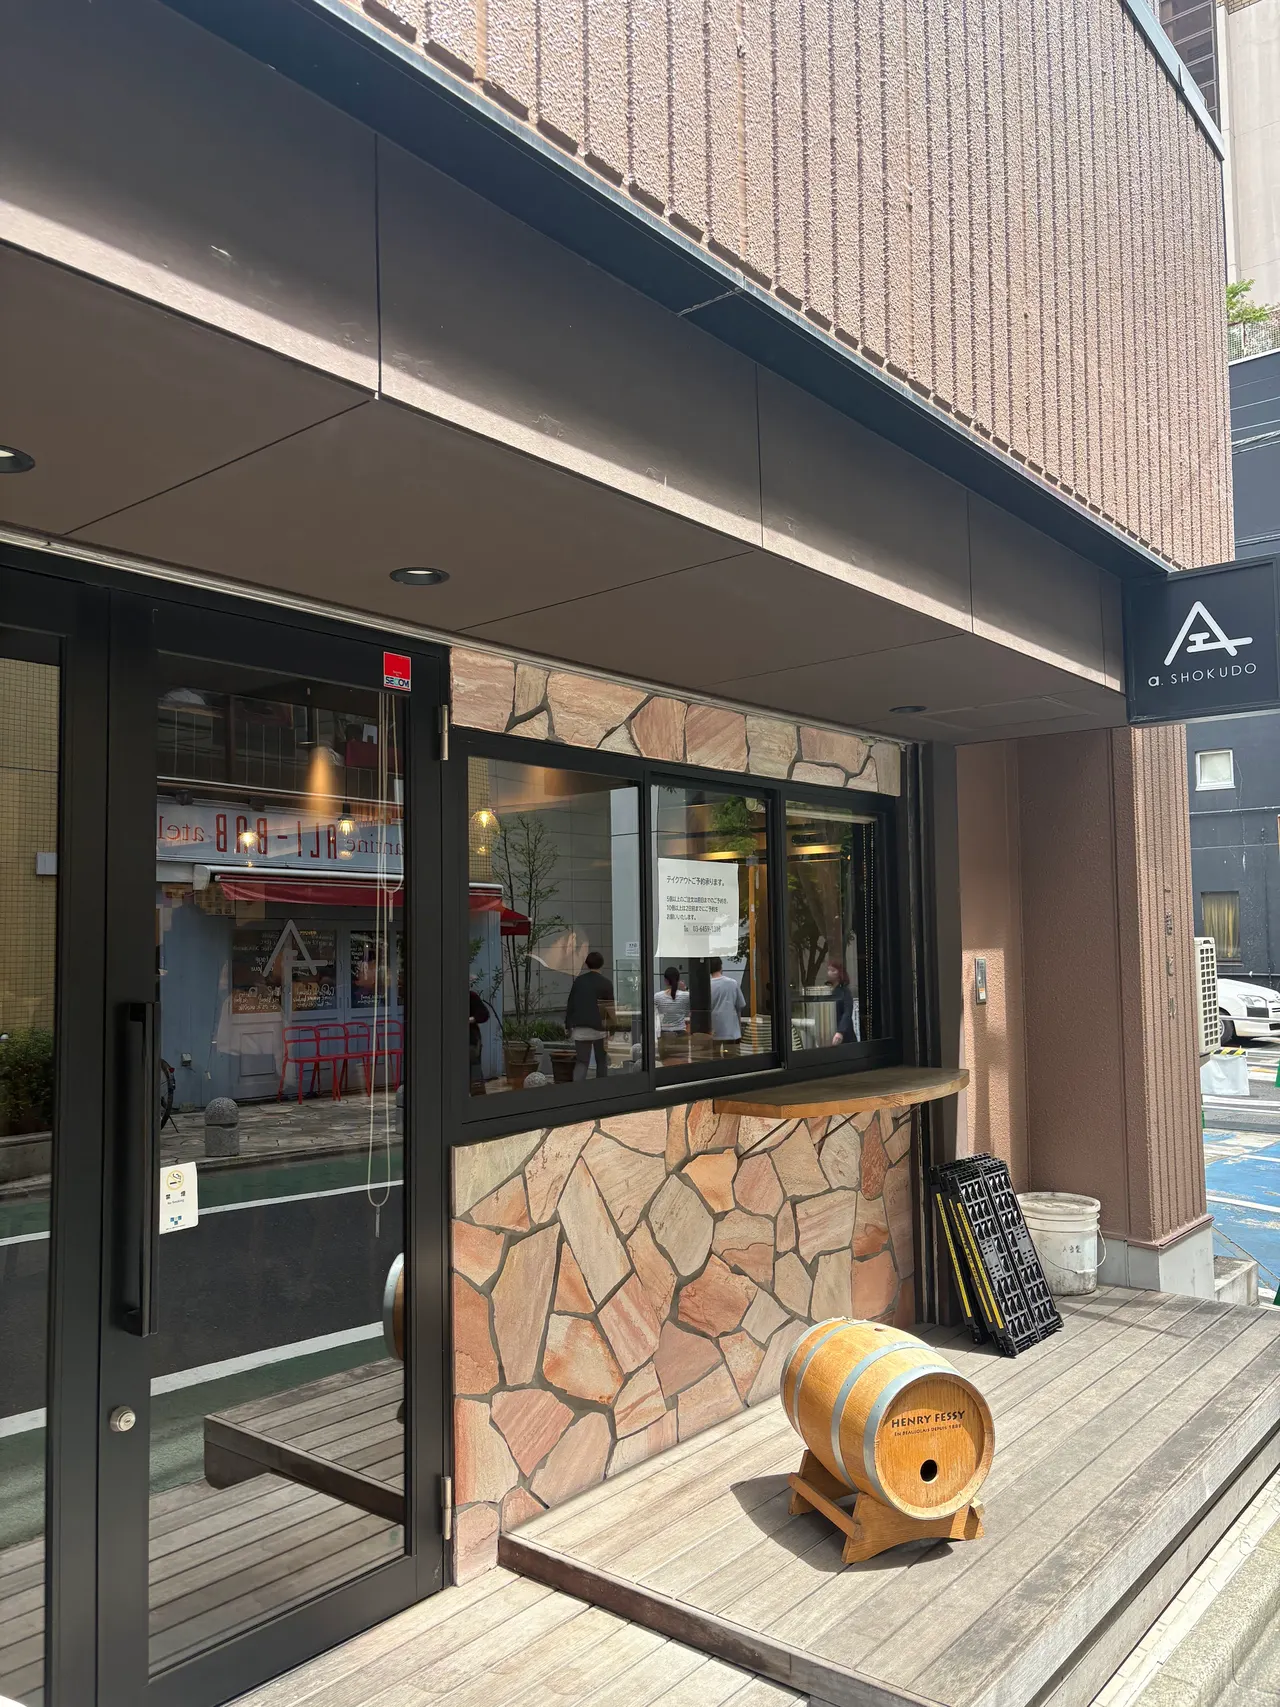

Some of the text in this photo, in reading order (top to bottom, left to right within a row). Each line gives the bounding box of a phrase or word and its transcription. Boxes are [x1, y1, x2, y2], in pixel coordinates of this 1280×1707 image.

[385, 676, 410, 688] SECOM
[1170, 662, 1257, 685] SHOKUDO
[891, 1410, 965, 1428] HENRY FESSY
